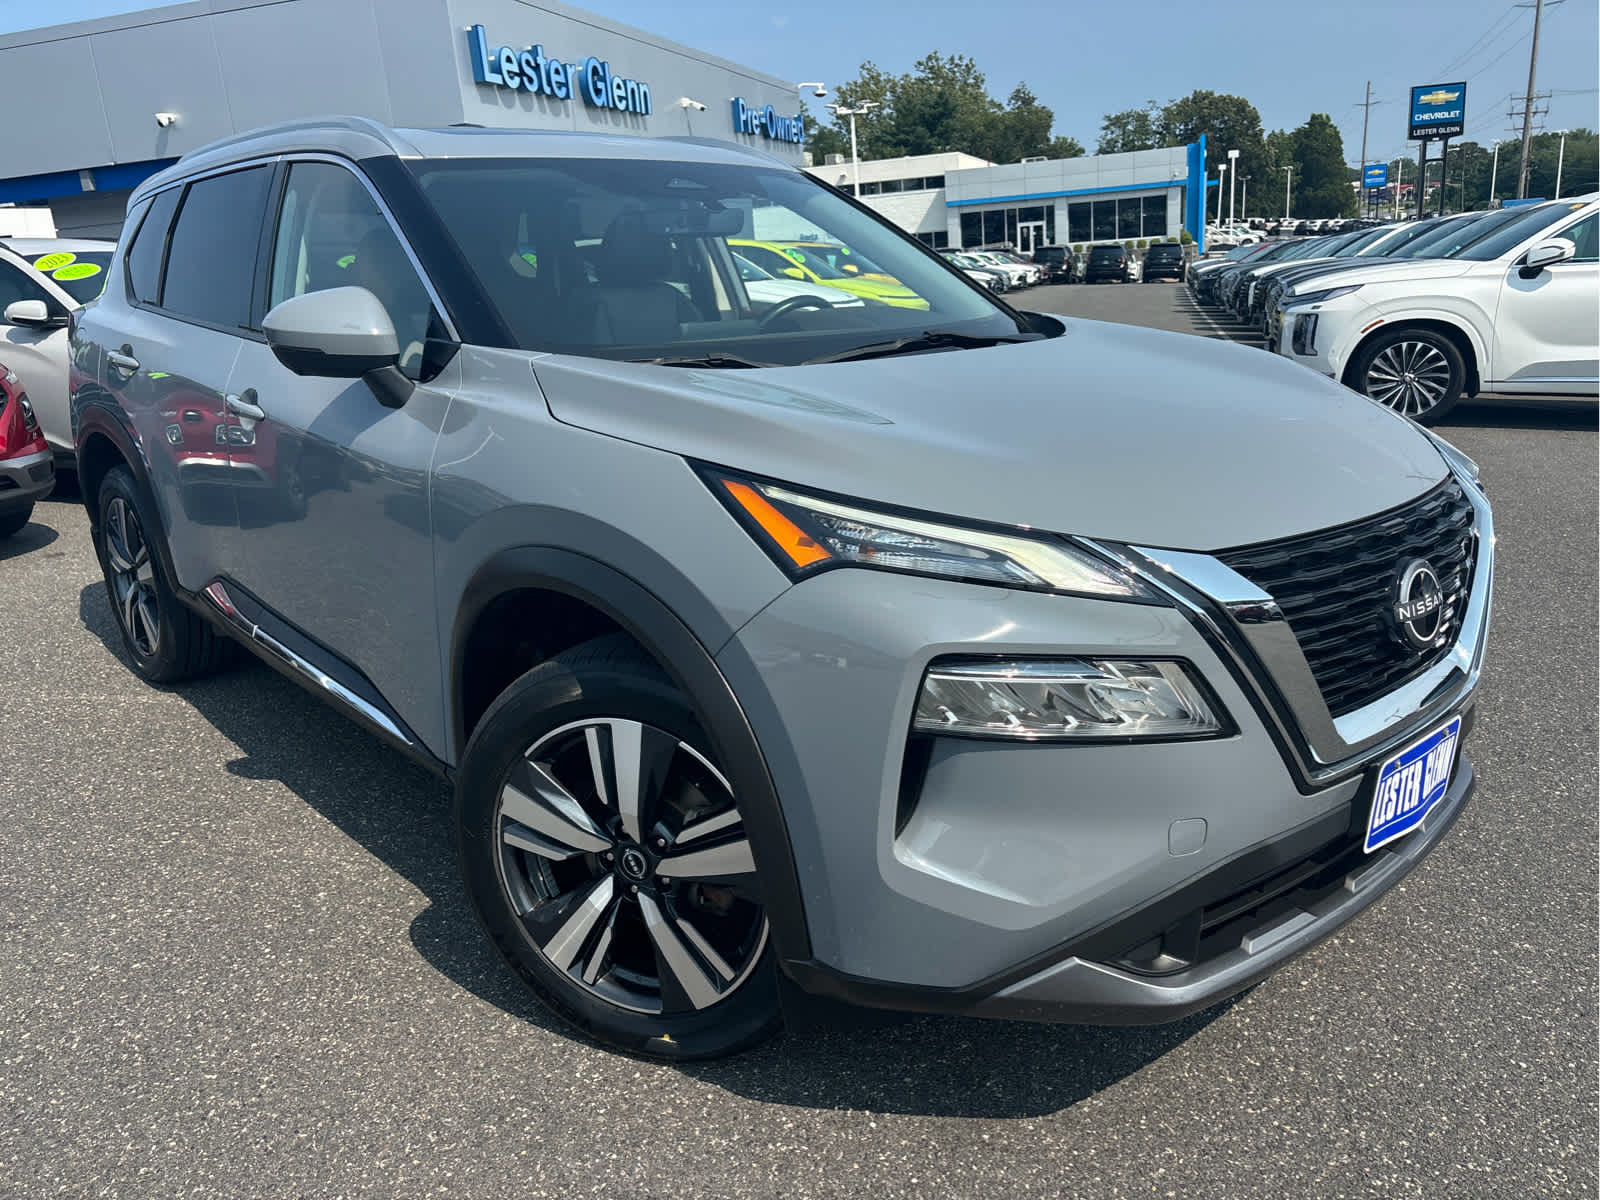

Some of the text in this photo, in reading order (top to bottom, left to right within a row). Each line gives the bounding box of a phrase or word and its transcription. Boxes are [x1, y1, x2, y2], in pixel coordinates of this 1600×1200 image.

[468, 24, 651, 115] Lester Glenn
[733, 97, 805, 143] Pre-Owned
[1413, 126, 1460, 136] LESTER GLENN
[1414, 110, 1461, 121] CHEVROLET
[1398, 591, 1442, 620] NISSAN
[1373, 735, 1456, 829] LESTER GLENN
